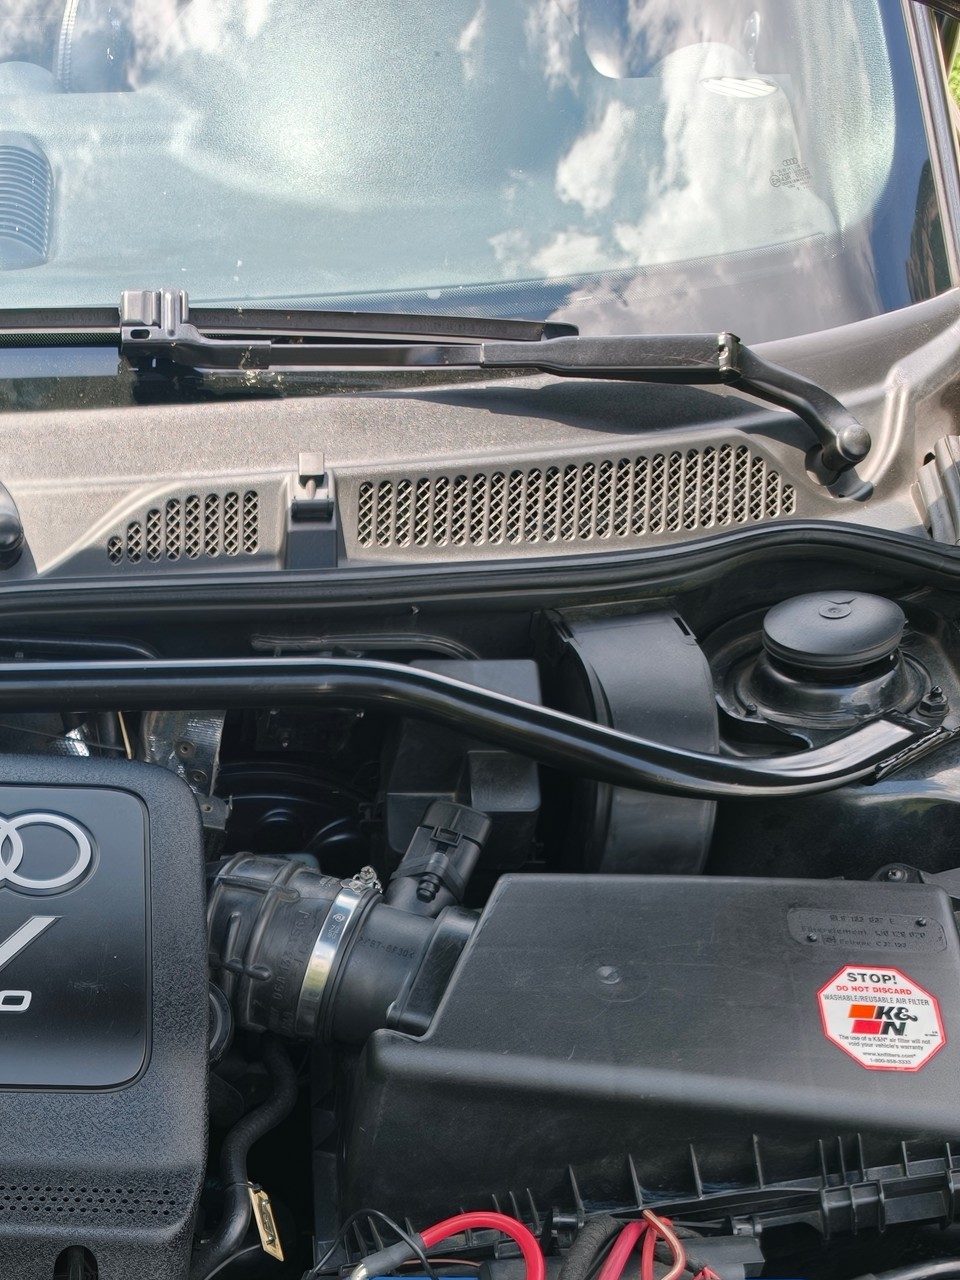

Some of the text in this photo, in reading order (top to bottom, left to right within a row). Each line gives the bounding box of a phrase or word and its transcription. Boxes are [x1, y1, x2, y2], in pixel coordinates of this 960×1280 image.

[847, 972, 897, 985] STOP!
[872, 986, 912, 996] DISCARD
[823, 994, 930, 1007] WASHABLE/REUSABLE AIR FILTER
